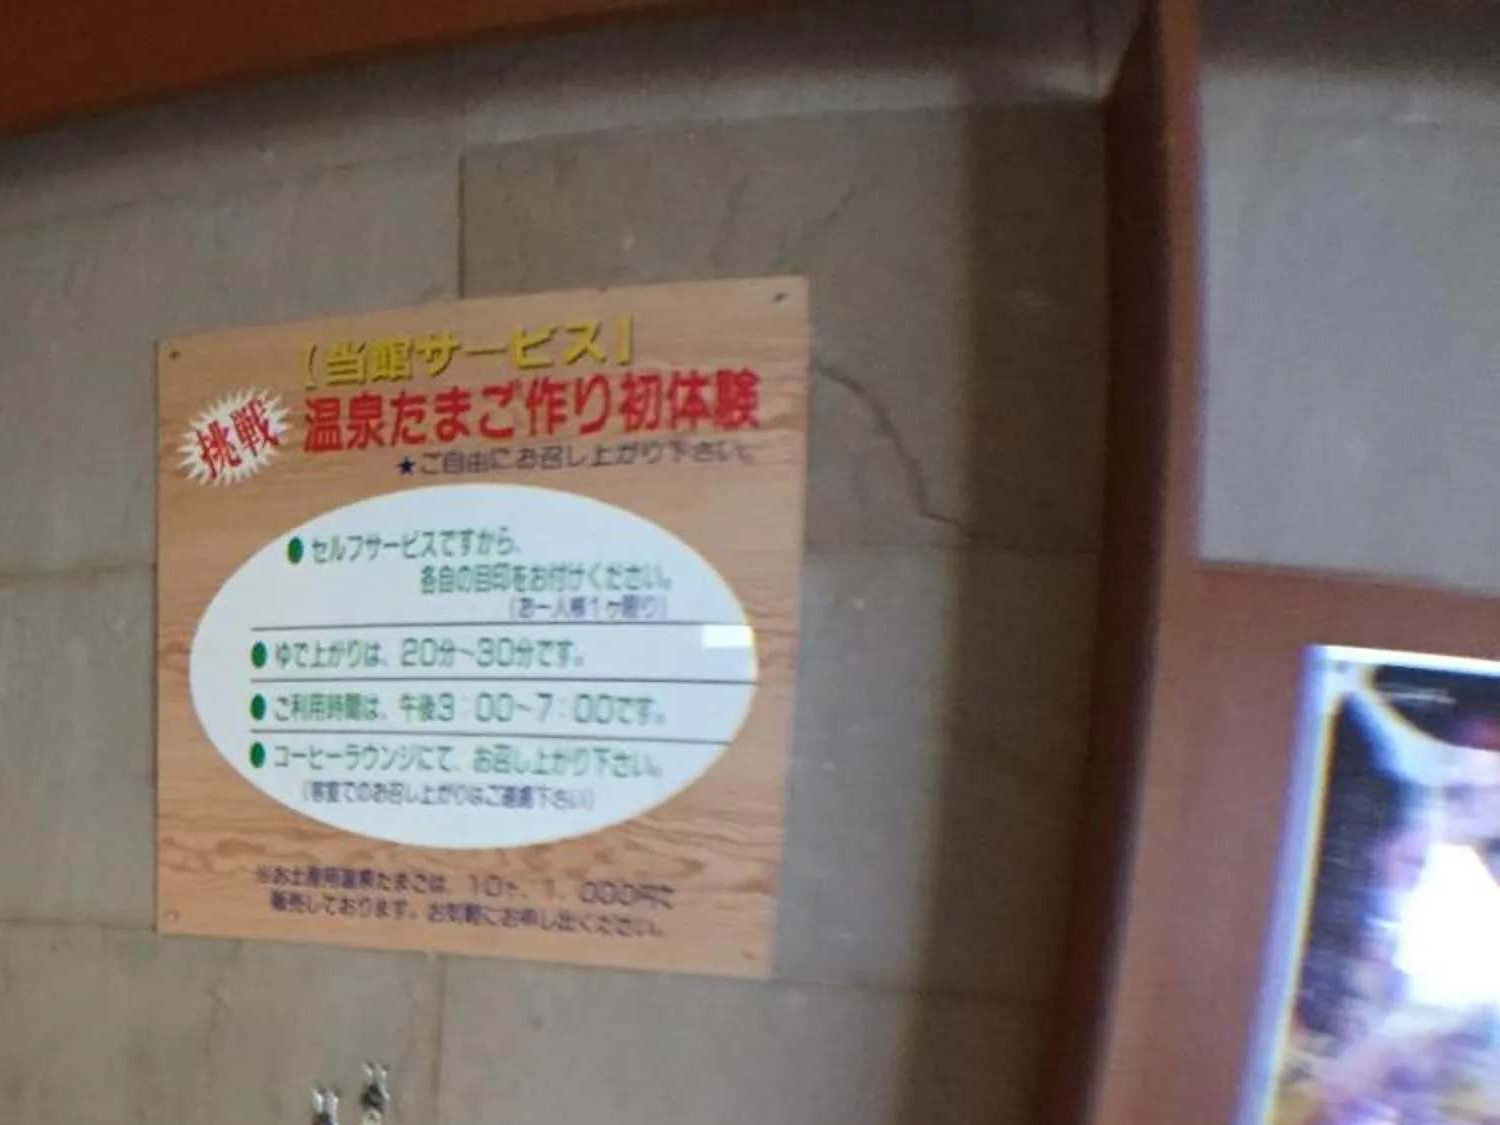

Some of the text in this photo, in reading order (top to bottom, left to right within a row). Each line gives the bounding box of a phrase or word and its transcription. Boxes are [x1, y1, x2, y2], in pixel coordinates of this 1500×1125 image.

[196, 399, 278, 479] 挑戦
[303, 367, 760, 453] 温泉たまご作り初体験
